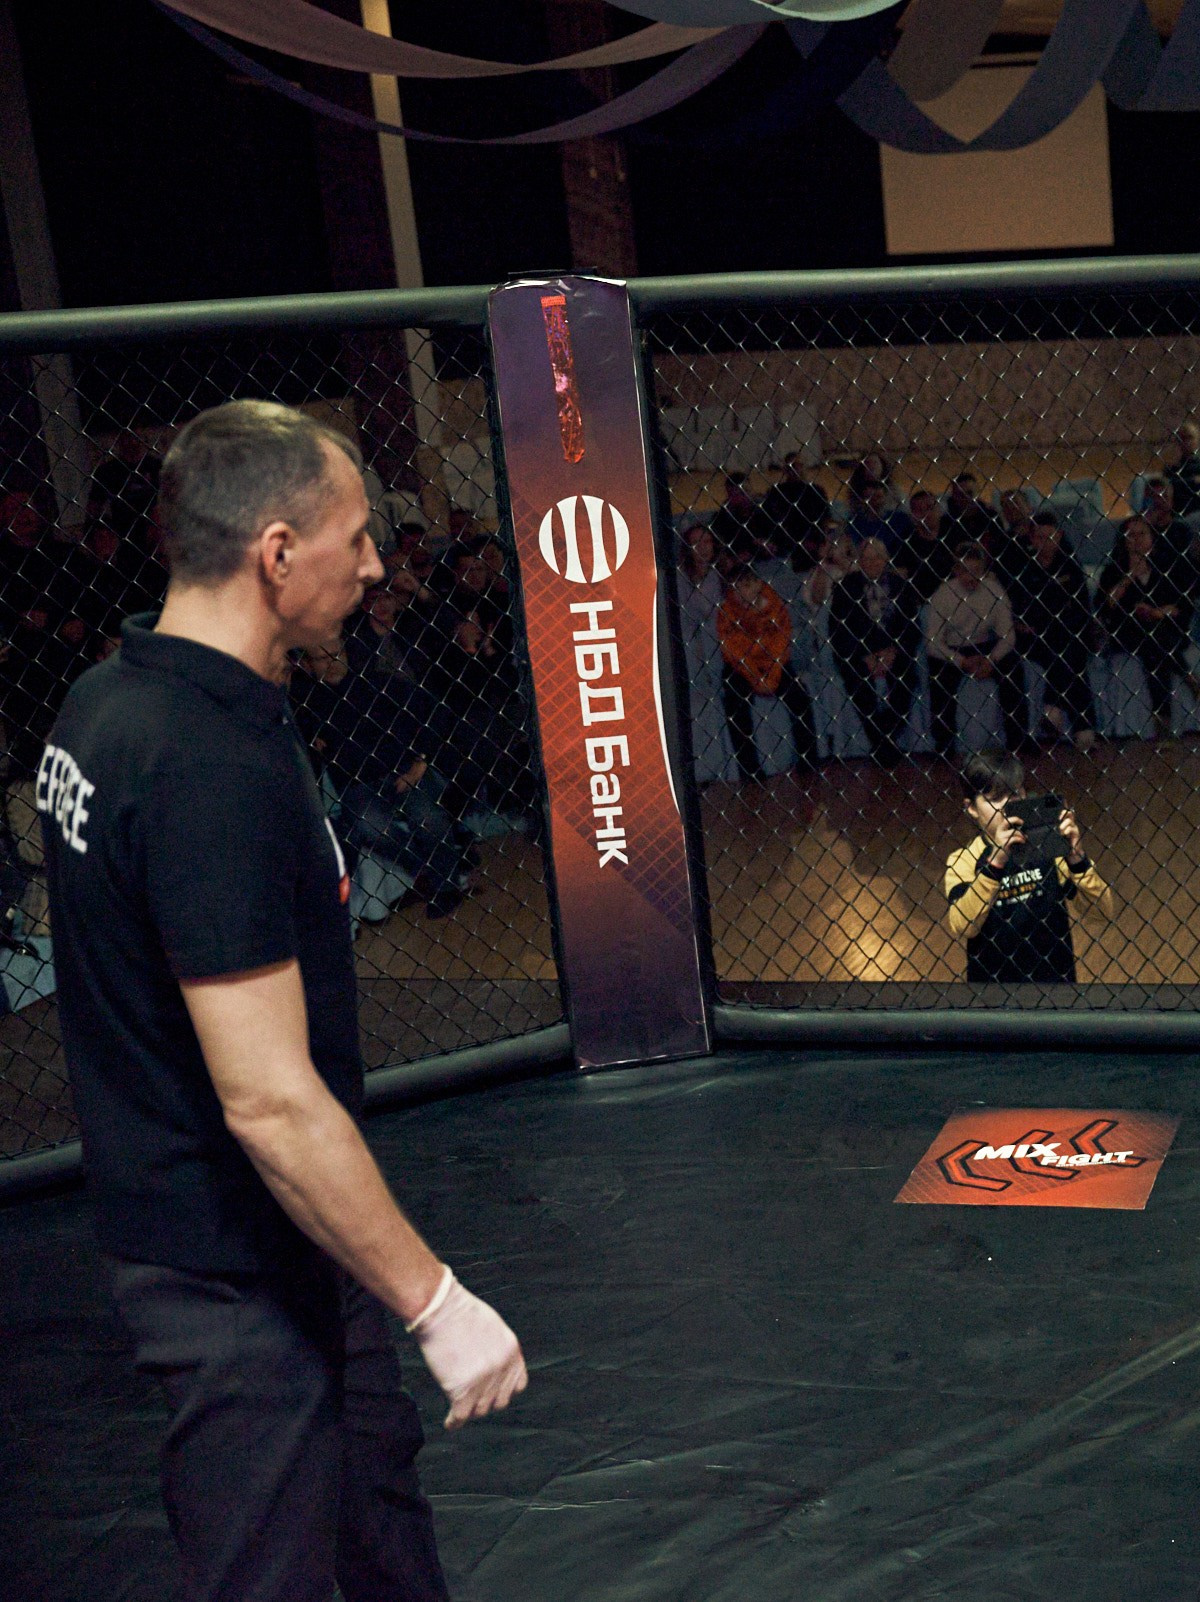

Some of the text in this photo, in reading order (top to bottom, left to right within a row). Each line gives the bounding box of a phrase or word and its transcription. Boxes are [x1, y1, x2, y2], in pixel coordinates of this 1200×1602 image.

[569, 600, 631, 869] НБД Банк
[973, 1142, 1061, 1160] MIX
[1040, 1150, 1134, 1166] FIGHT
